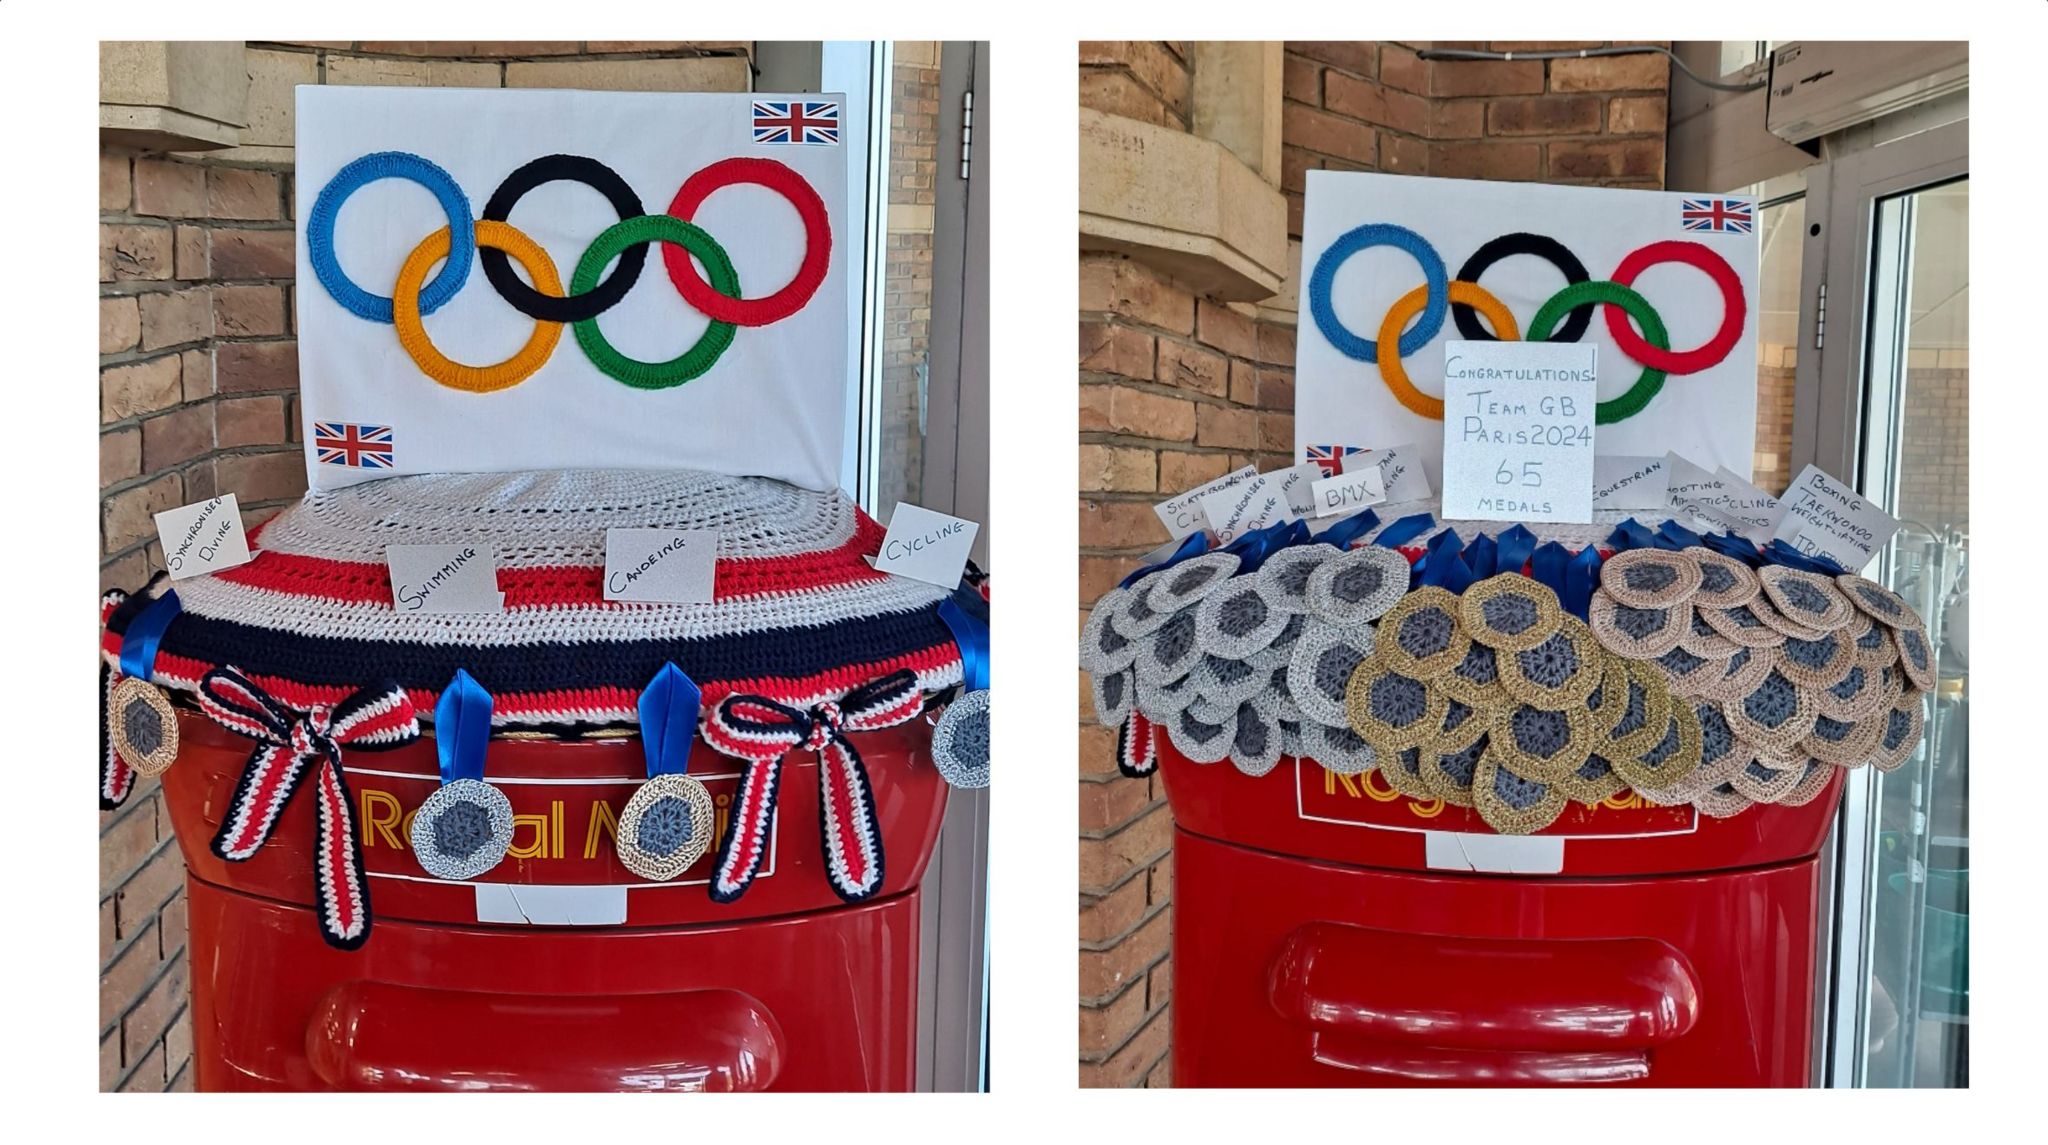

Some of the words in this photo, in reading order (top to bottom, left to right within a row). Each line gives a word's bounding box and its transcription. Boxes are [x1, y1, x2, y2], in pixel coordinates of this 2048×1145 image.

[1445, 348, 1596, 382] CONGRATULATIONS!
[1467, 390, 1527, 415] TEAM
[1540, 396, 1577, 417] GB
[1281, 472, 1300, 492] ING
[1495, 459, 1543, 487] 65
[1325, 480, 1376, 507] BMX
[1477, 499, 1553, 513] MEDALS
[1728, 499, 1777, 509] CLING
[1176, 511, 1205, 529] CLI
[1800, 486, 1873, 541] TAEKWONDO
[167, 498, 222, 571] SYNCHRONISED
[199, 520, 231, 562] DIVING
[885, 521, 964, 561] CYCLING
[399, 547, 476, 611] SWIMMING
[609, 537, 686, 594] CANOEING
[361, 789, 564, 859] Ral
